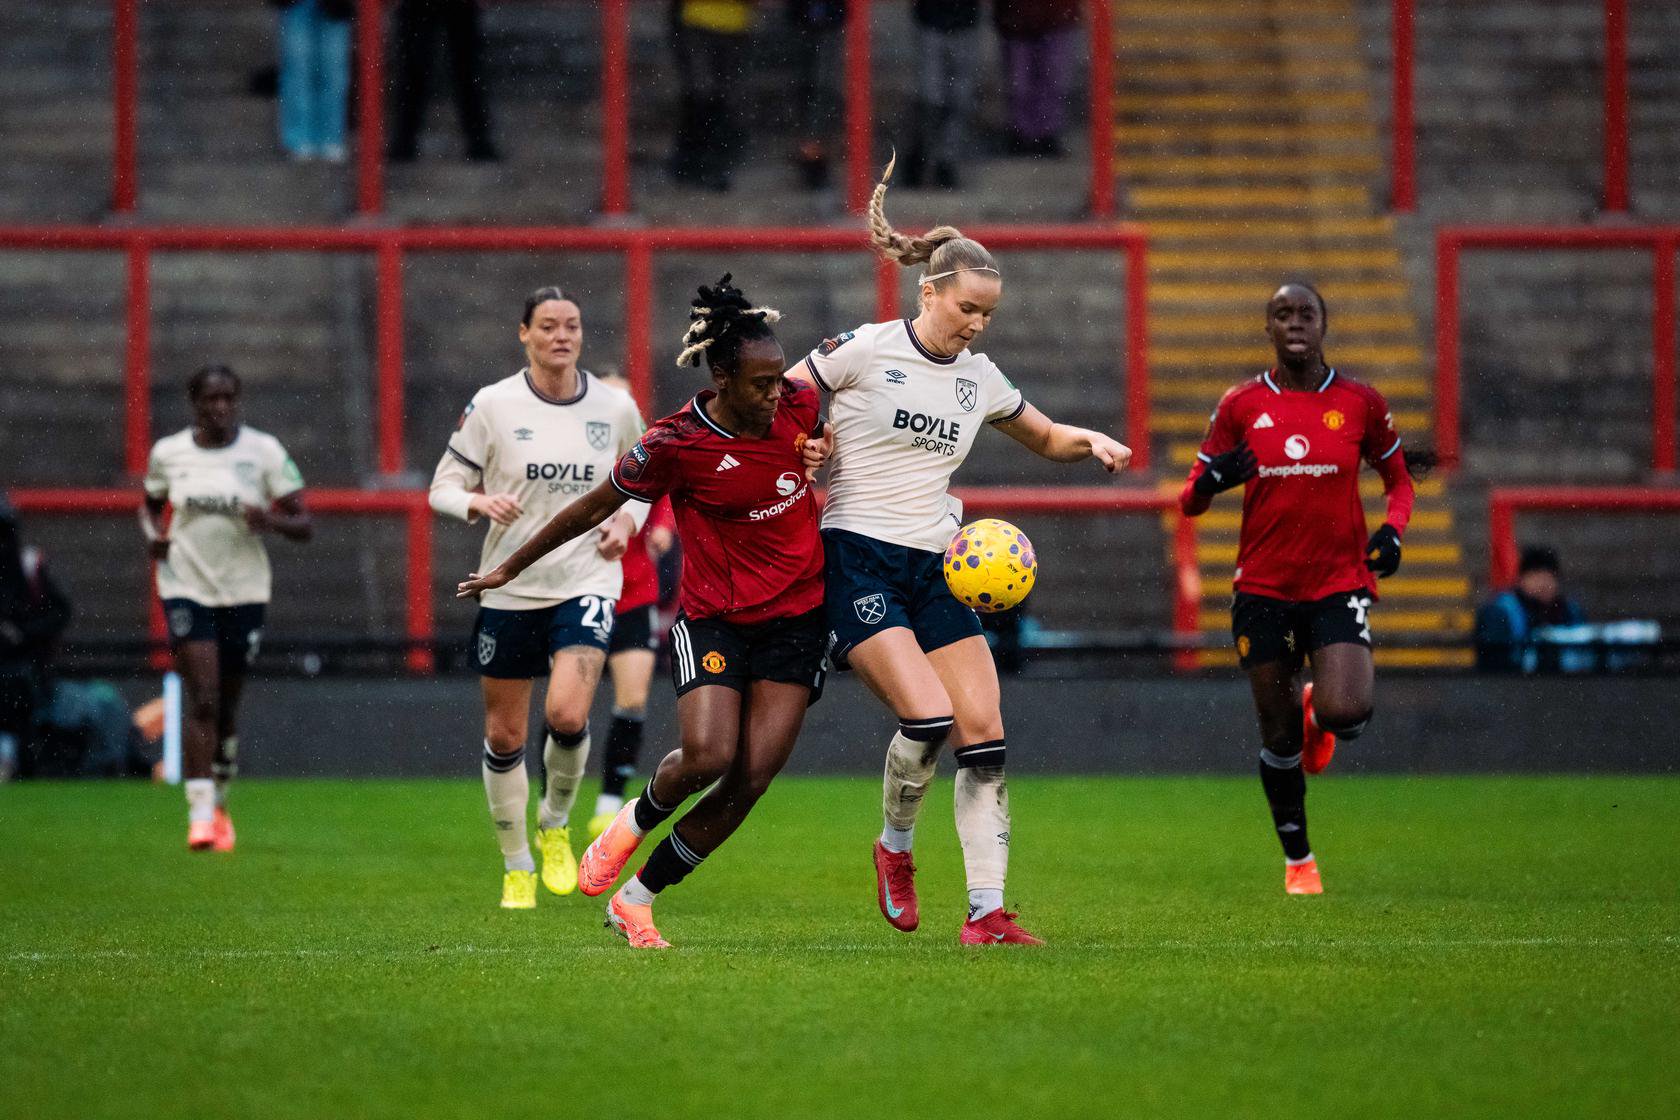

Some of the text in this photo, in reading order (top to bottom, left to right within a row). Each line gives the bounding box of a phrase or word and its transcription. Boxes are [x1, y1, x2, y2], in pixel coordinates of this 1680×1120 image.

[892, 408, 960, 442] BOYLE
[911, 436, 956, 457] SPORTS
[526, 463, 595, 482] BOYLE
[1258, 462, 1338, 478] Snapdragon
